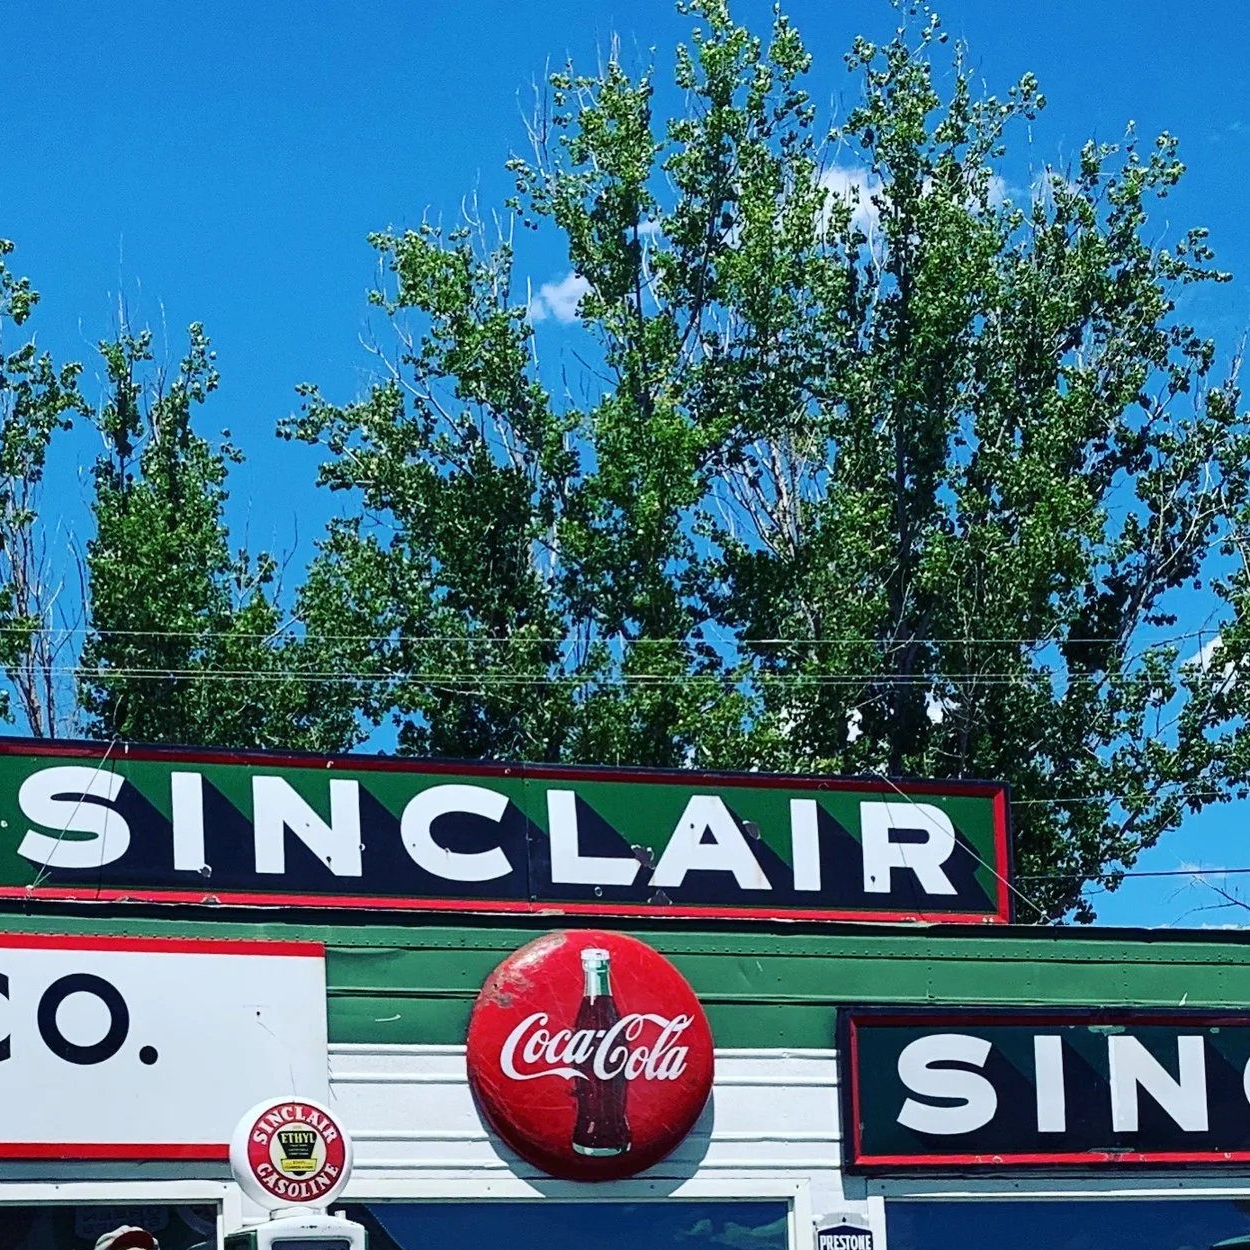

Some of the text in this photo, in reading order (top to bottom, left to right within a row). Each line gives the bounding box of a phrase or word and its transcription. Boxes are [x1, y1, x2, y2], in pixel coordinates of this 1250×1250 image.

[17, 765, 958, 895] SINCLAIR
[500, 1012, 695, 1081] Coca-Cola
[896, 1033, 1250, 1135] SIN
[253, 1105, 338, 1145] SINCLAIR
[281, 1132, 316, 1144] ETHYL
[256, 1162, 339, 1198] GASOLINE
[819, 1234, 872, 1250] PRESTONE
